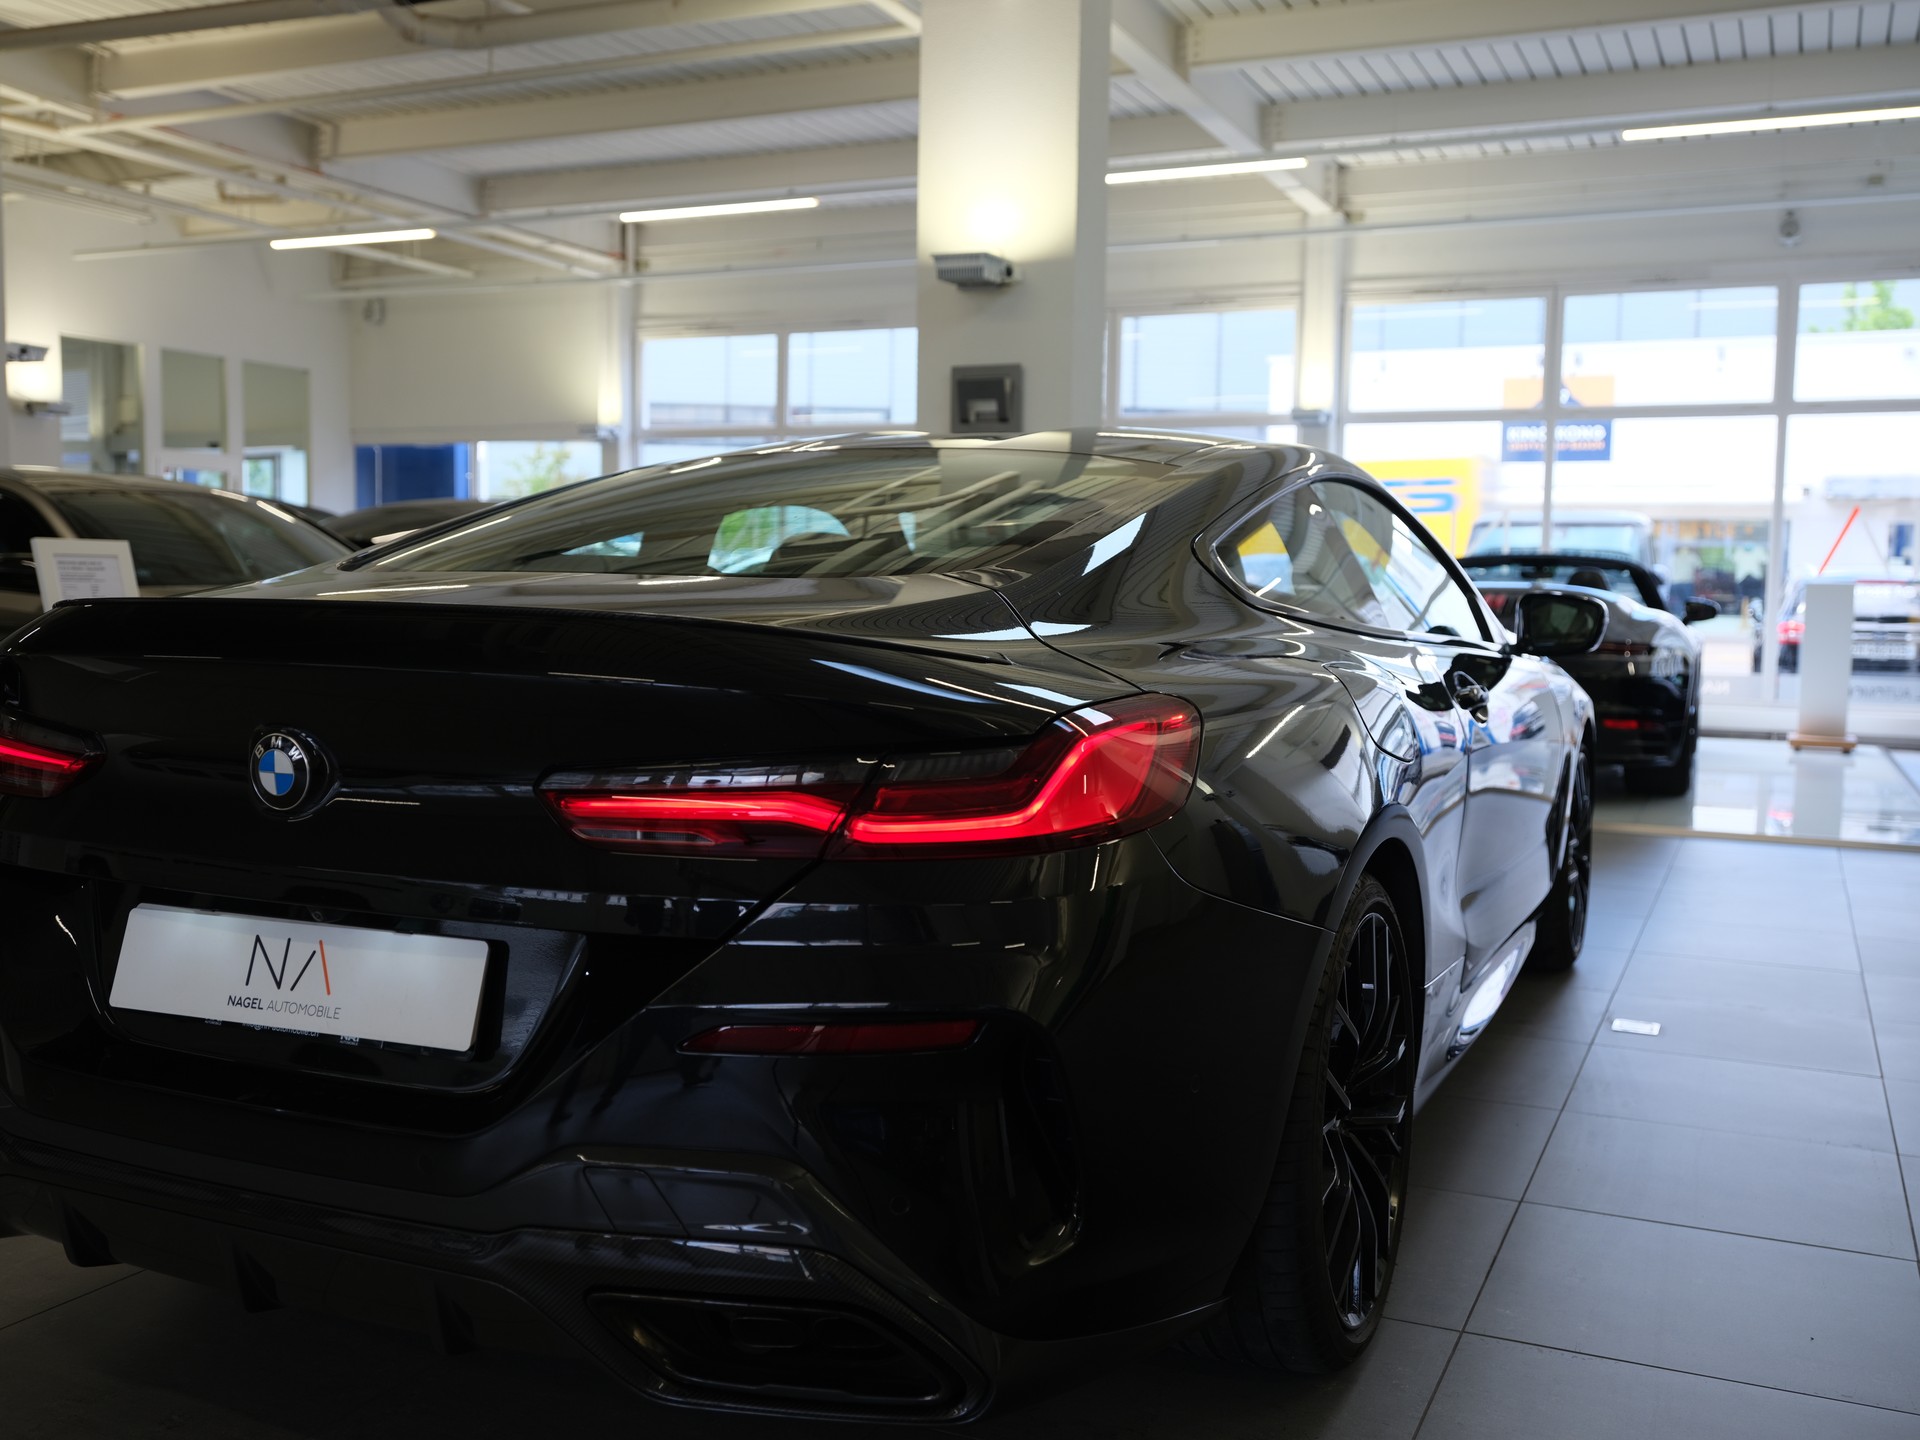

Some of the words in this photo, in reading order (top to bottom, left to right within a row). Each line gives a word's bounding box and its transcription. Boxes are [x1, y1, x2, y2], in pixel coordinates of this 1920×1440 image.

[255, 735, 303, 762] BMW
[227, 994, 264, 1011] NAGEL
[266, 999, 342, 1020] AUTOMOBILE
